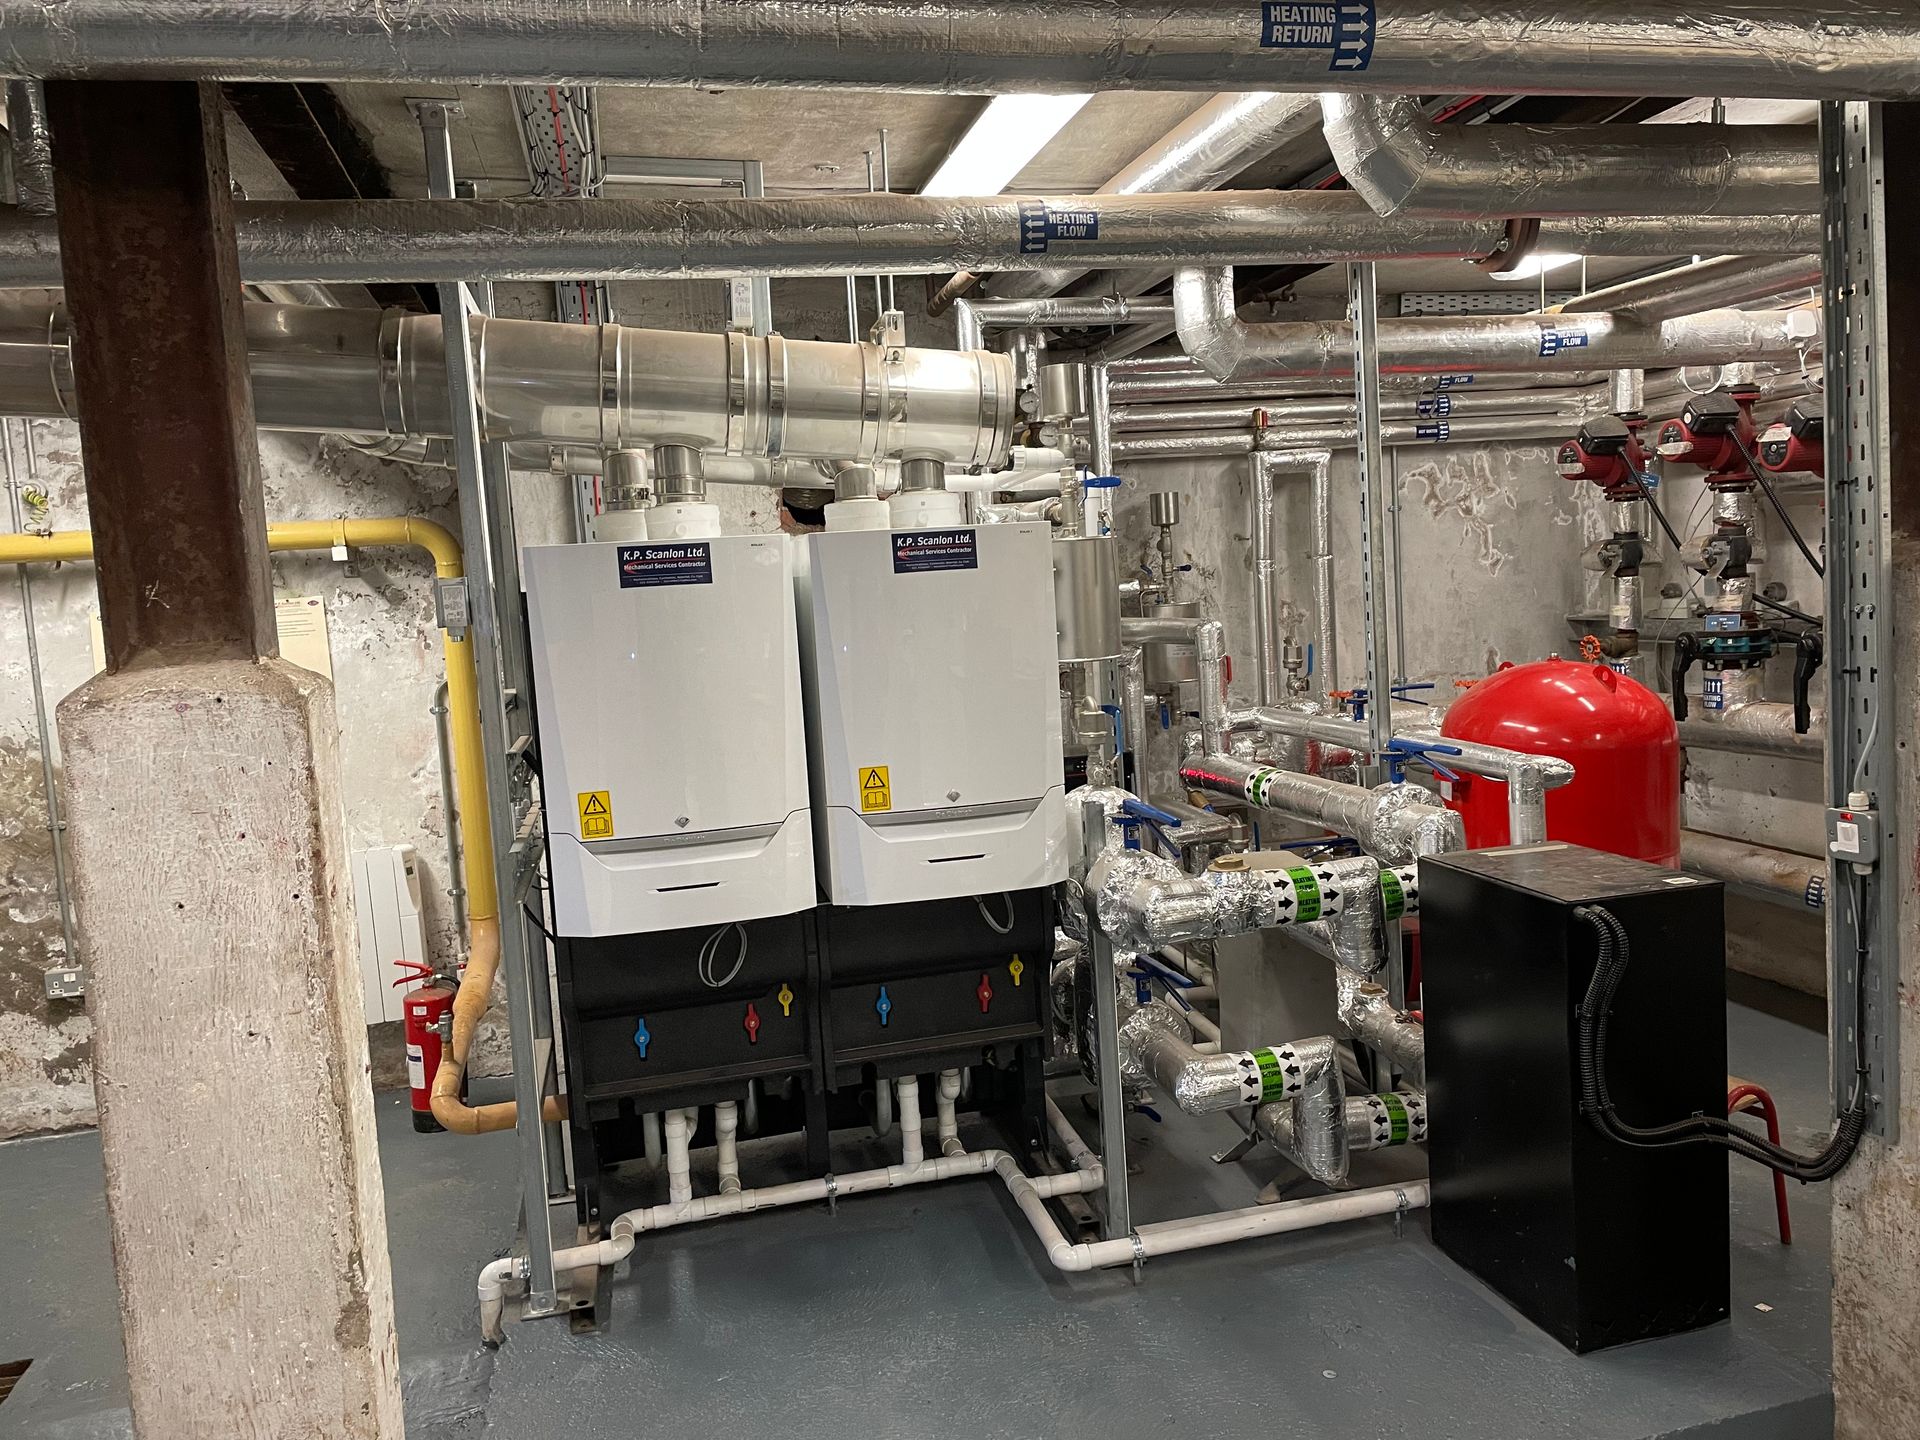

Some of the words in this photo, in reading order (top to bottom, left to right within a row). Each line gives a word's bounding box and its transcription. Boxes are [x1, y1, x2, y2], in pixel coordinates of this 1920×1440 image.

[1270, 5, 1336, 23] HEATING
[1272, 25, 1333, 43] RETURN
[1048, 213, 1094, 224] HEATING
[1057, 225, 1087, 237] FLOW
[1562, 338, 1582, 346] FLOW
[897, 537, 915, 547] K.P.
[917, 535, 953, 546] Scanlon
[955, 534, 972, 544] Ltd.
[623, 550, 643, 561] K.P.
[645, 548, 684, 559] Scanlon
[687, 547, 706, 557] Ltd.
[897, 549, 925, 557] Mechanical
[624, 563, 654, 571] Mechanical
